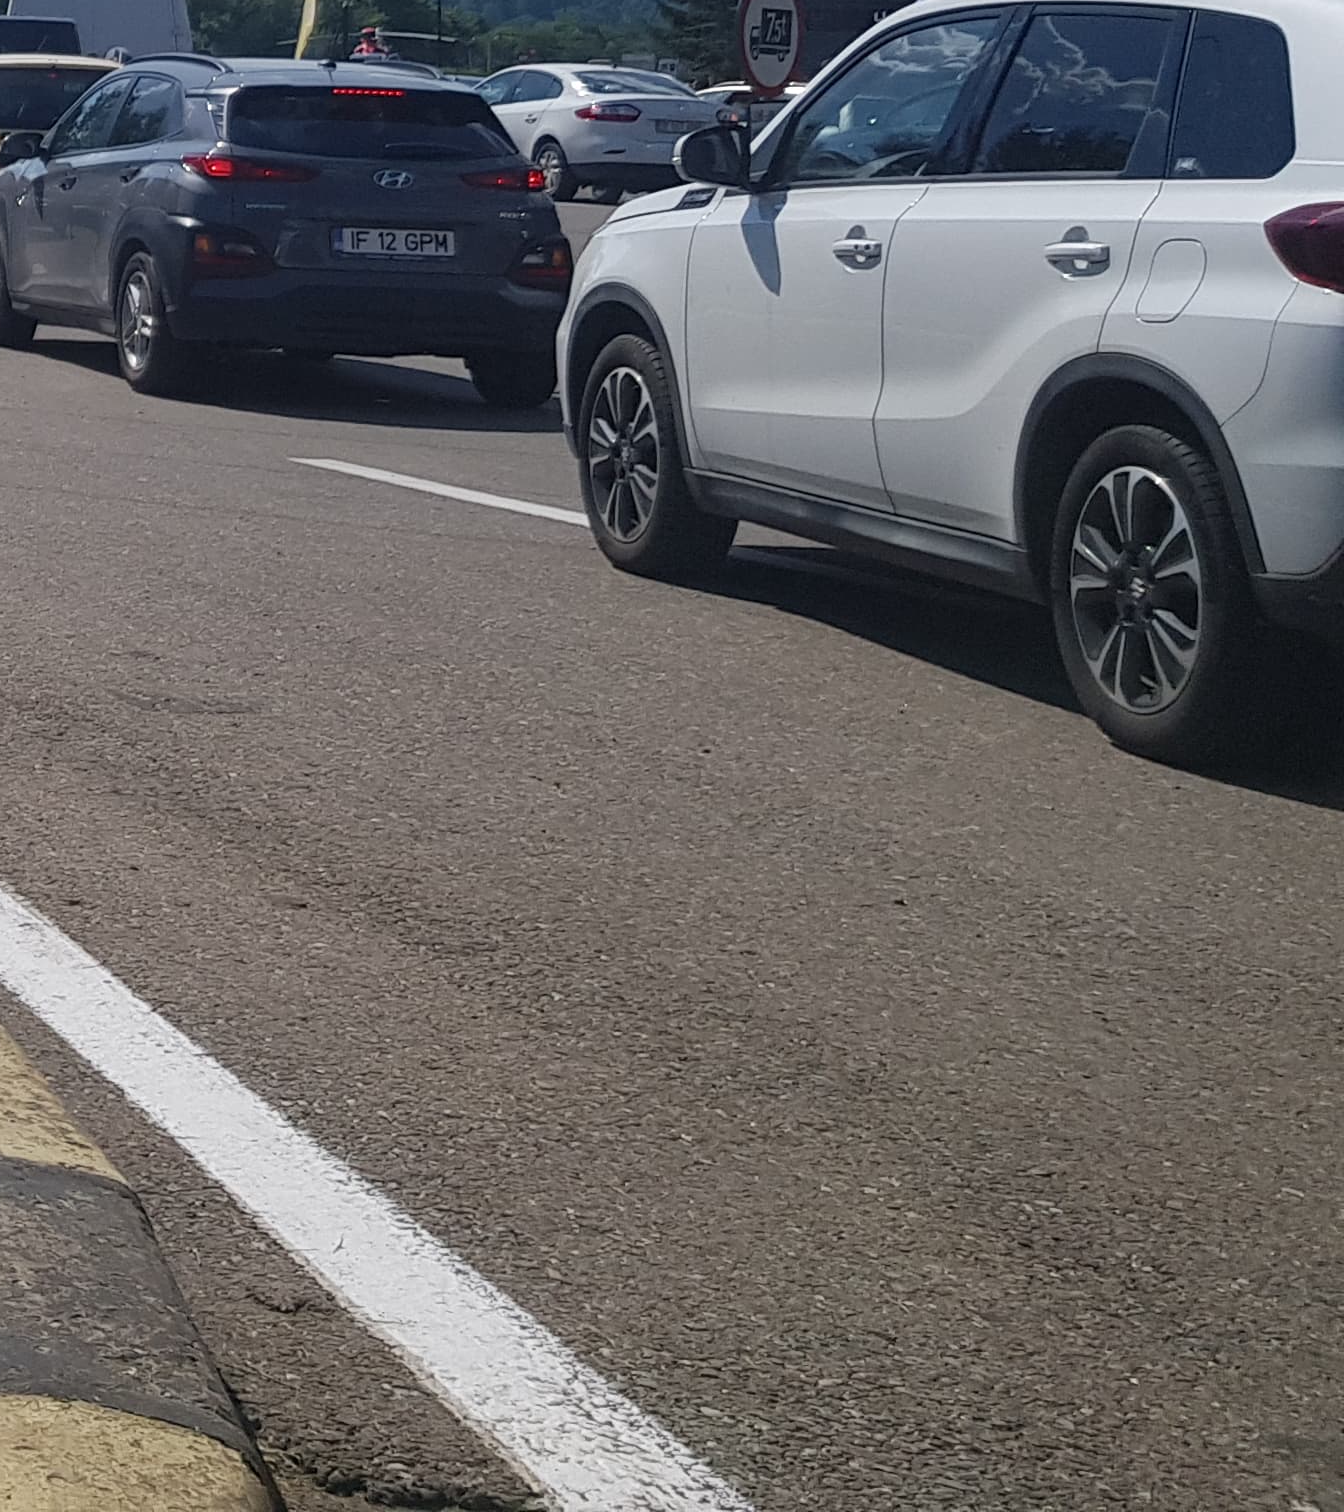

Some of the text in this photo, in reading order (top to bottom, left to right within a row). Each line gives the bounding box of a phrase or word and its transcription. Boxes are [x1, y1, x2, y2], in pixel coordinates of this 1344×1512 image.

[350, 230, 449, 253] IF 12 GPM
